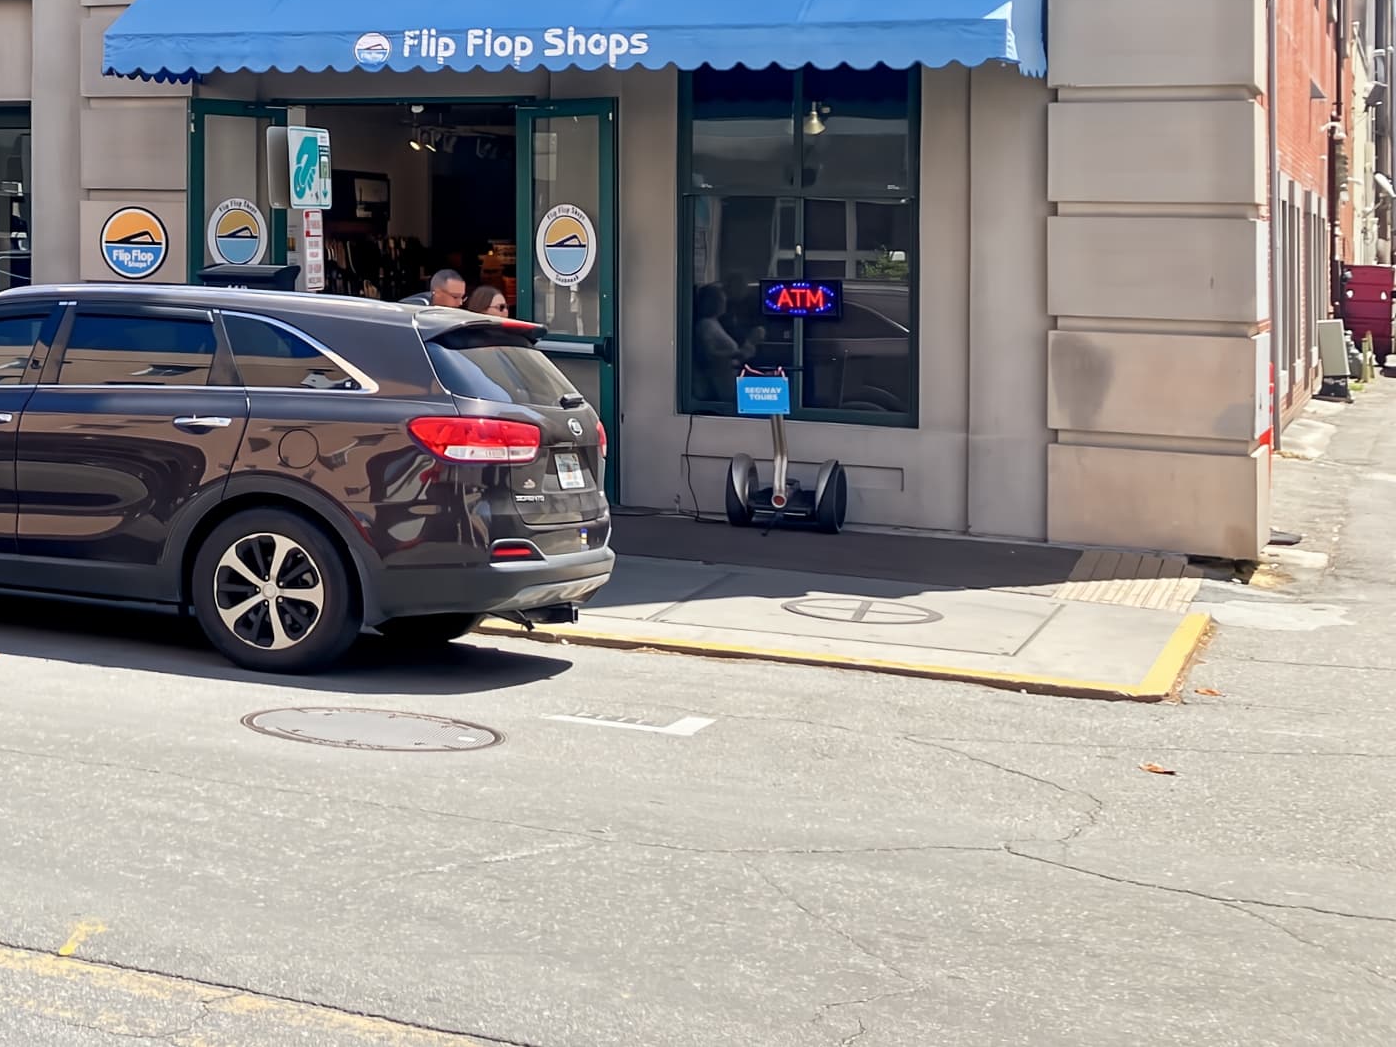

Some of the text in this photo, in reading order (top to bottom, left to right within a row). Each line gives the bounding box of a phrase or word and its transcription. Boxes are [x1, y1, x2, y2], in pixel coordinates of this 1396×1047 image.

[403, 26, 649, 69] Flip Flop Shops
[112, 249, 154, 266] Flip Flop
[777, 288, 824, 307] ATM
[749, 393, 779, 401] TOURS
